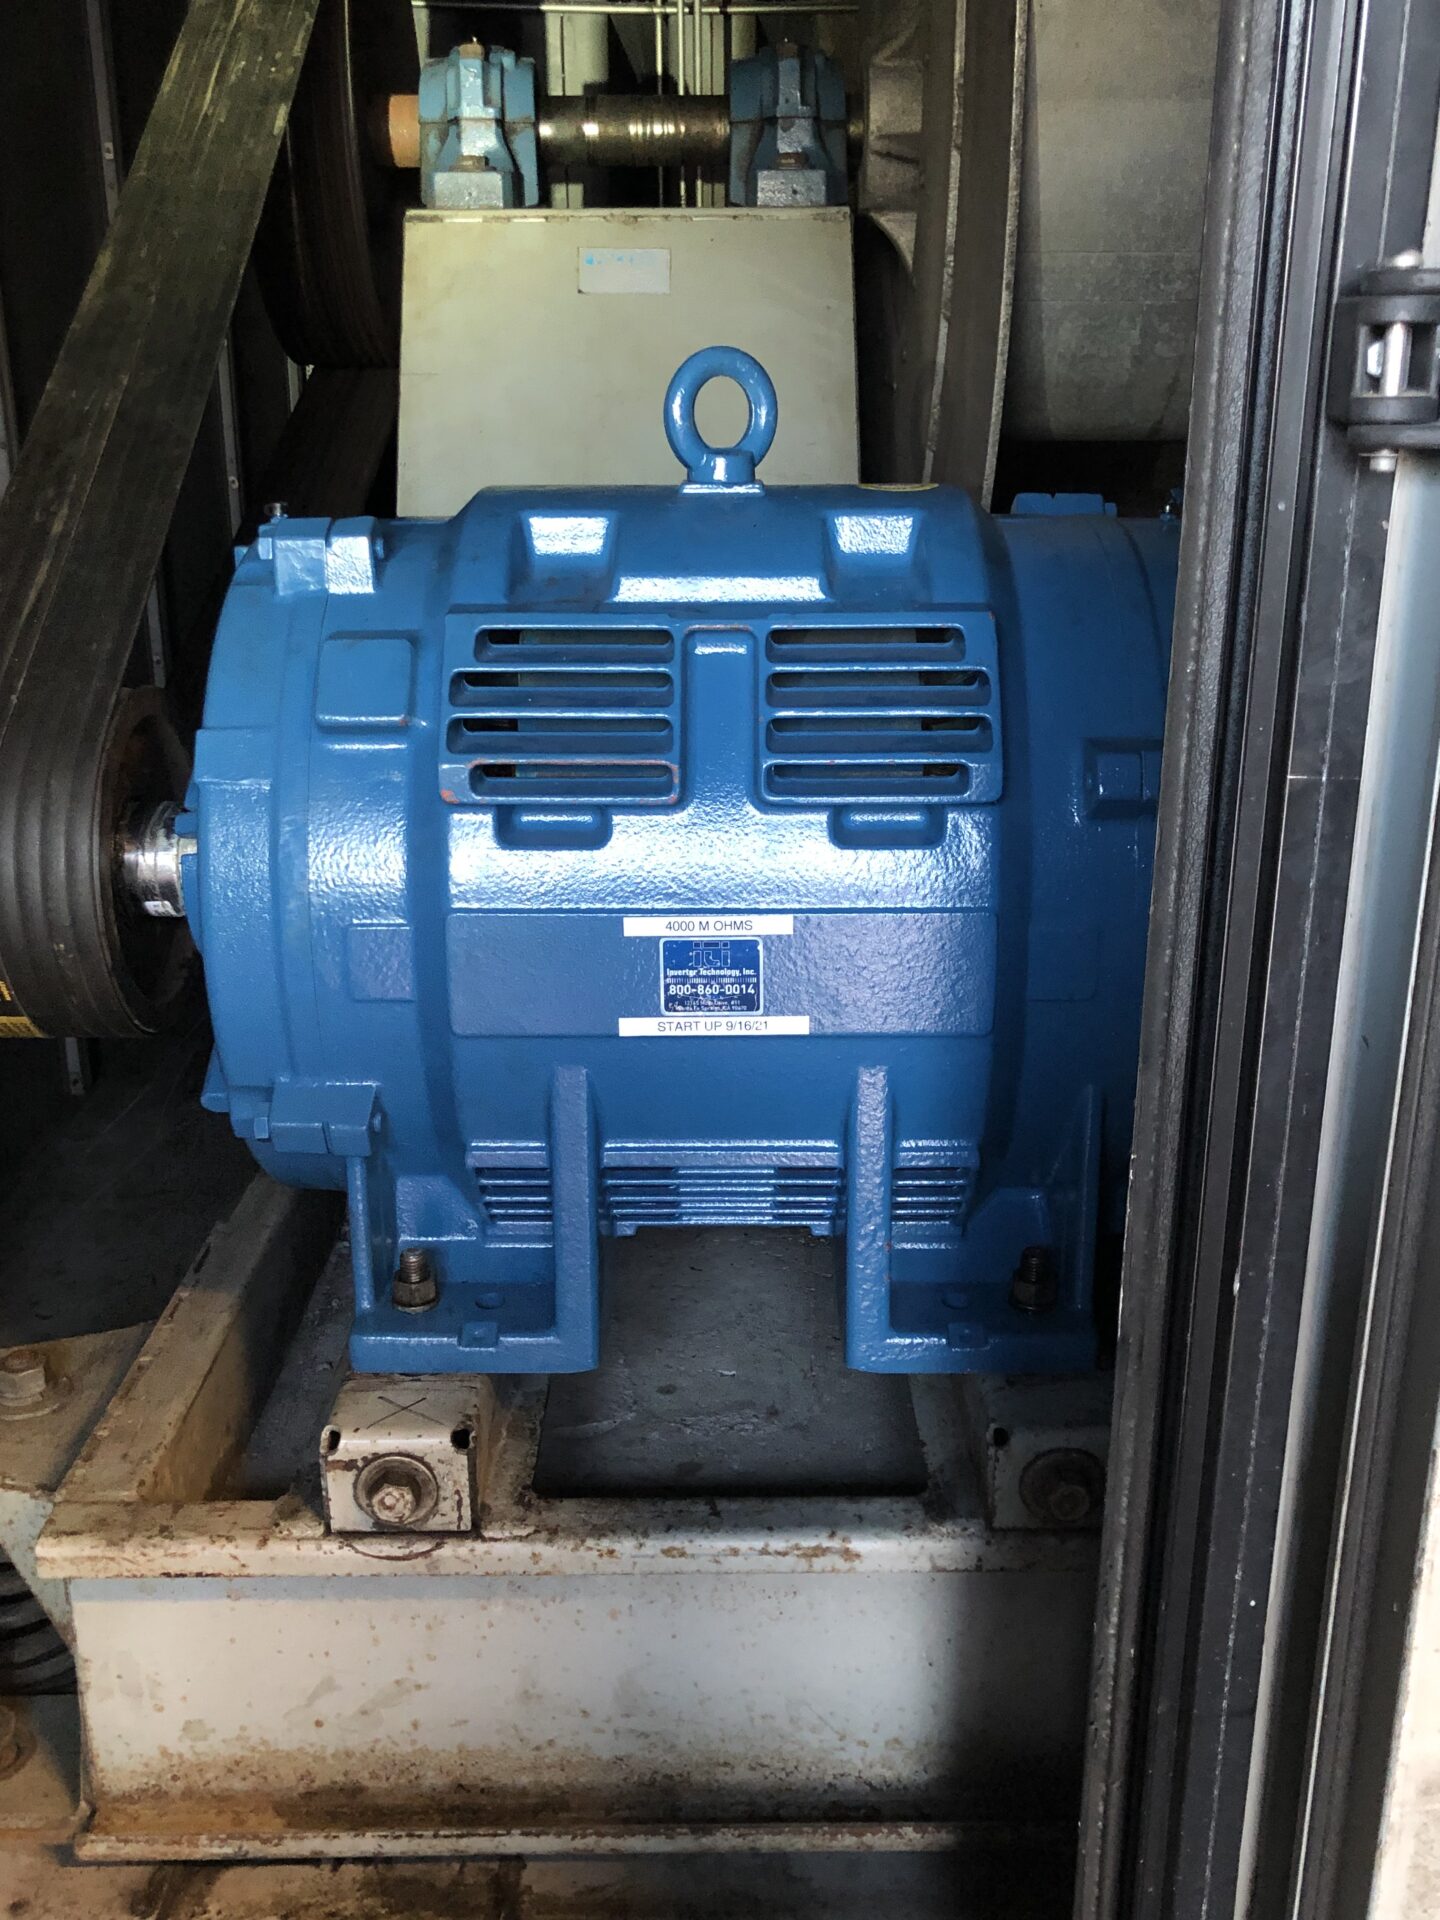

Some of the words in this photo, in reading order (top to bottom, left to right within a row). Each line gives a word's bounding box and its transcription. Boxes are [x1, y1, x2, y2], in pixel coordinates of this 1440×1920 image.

[665, 921, 695, 932] 4000
[698, 921, 710, 931] M
[713, 920, 753, 931] OHMS
[666, 968, 698, 977] Inverter
[698, 968, 741, 977] Technology,
[742, 968, 757, 976] Inc.
[669, 984, 756, 995] 800-860-0014
[657, 1021, 700, 1032] START
[704, 1021, 722, 1032] UP
[725, 1021, 768, 1032] 9/16/21
